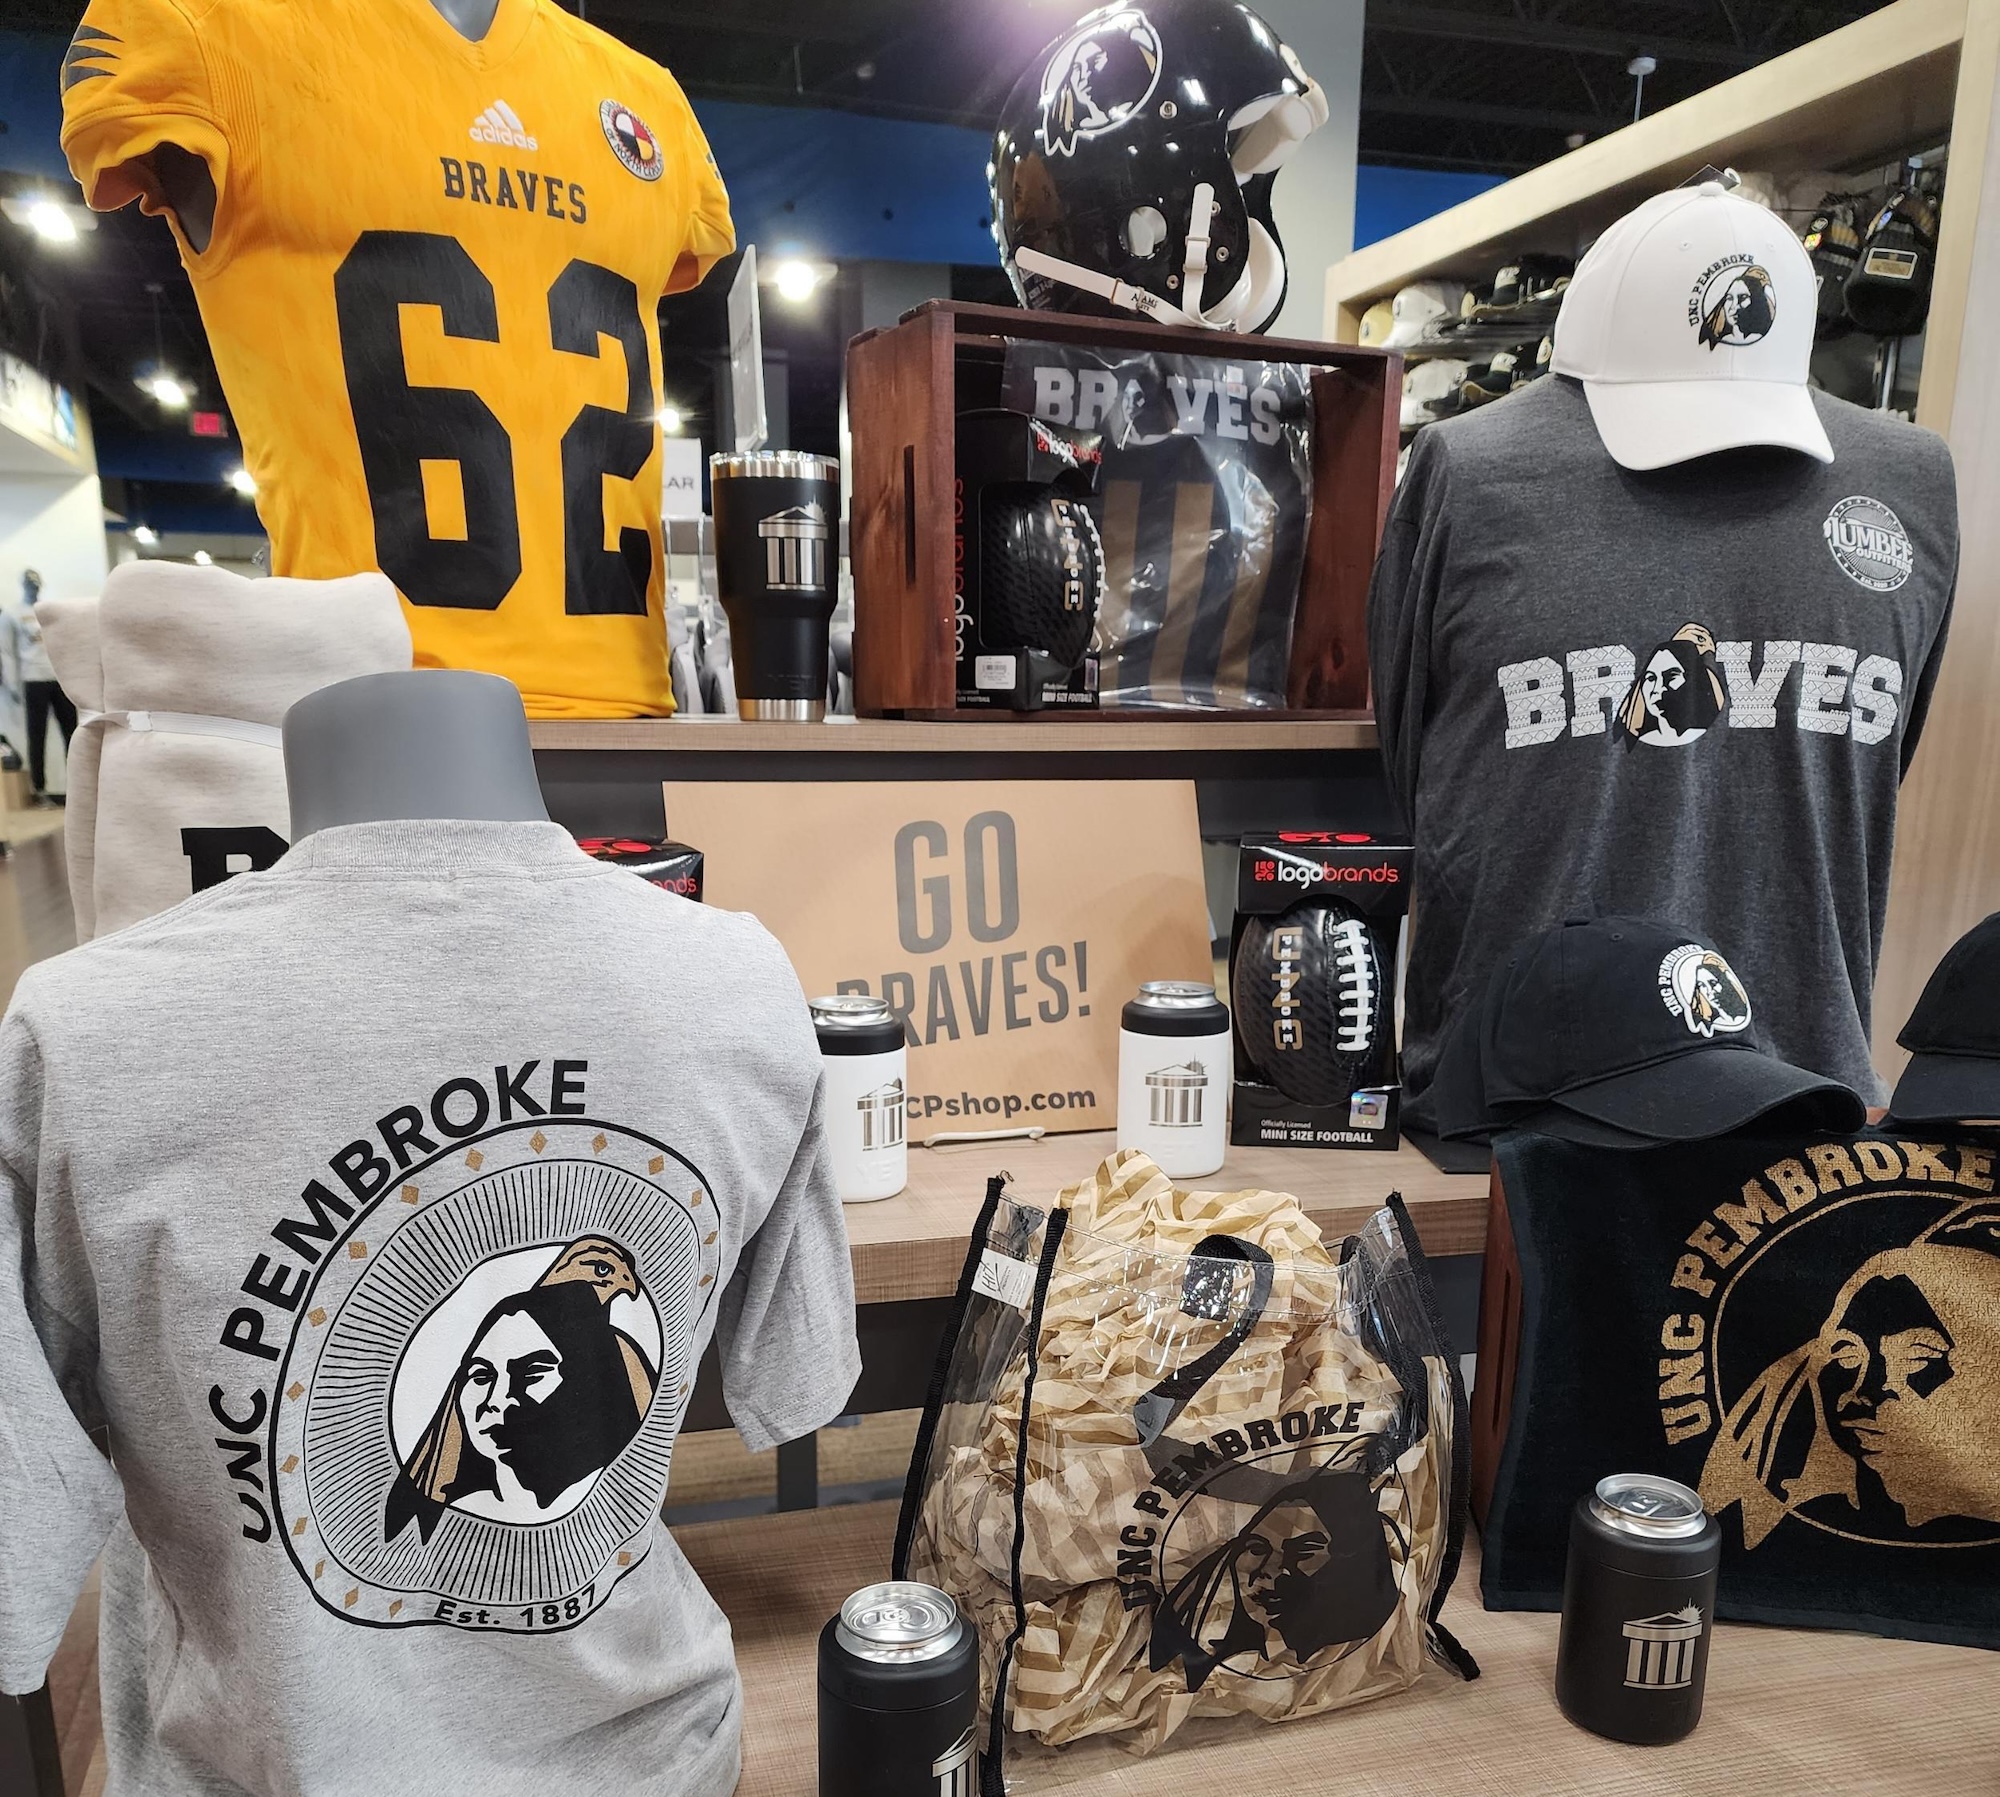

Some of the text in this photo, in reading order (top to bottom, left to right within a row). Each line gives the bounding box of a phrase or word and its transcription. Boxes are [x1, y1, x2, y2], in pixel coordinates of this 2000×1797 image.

[468, 125, 538, 151] adidas
[440, 157, 587, 224] BRAVES
[1131, 293, 1158, 309] AAMS
[1688, 253, 1755, 327] UNC PEMBROKE
[334, 230, 655, 616] 62
[894, 810, 1020, 954] GO
[1277, 860, 1399, 889] logobrands
[1658, 943, 1704, 1017] UNC PEMBROKE
[1260, 1129, 1375, 1143] MINI SIZE FOOTBALL
[219, 1059, 588, 1361] PEMBROKE
[1658, 1140, 1998, 1446] UNC PEMBROKE
[207, 1383, 272, 1544] UNC
[1117, 1402, 1365, 1612] UNC PEMBROKE
[433, 1583, 595, 1627] Est. 1887
